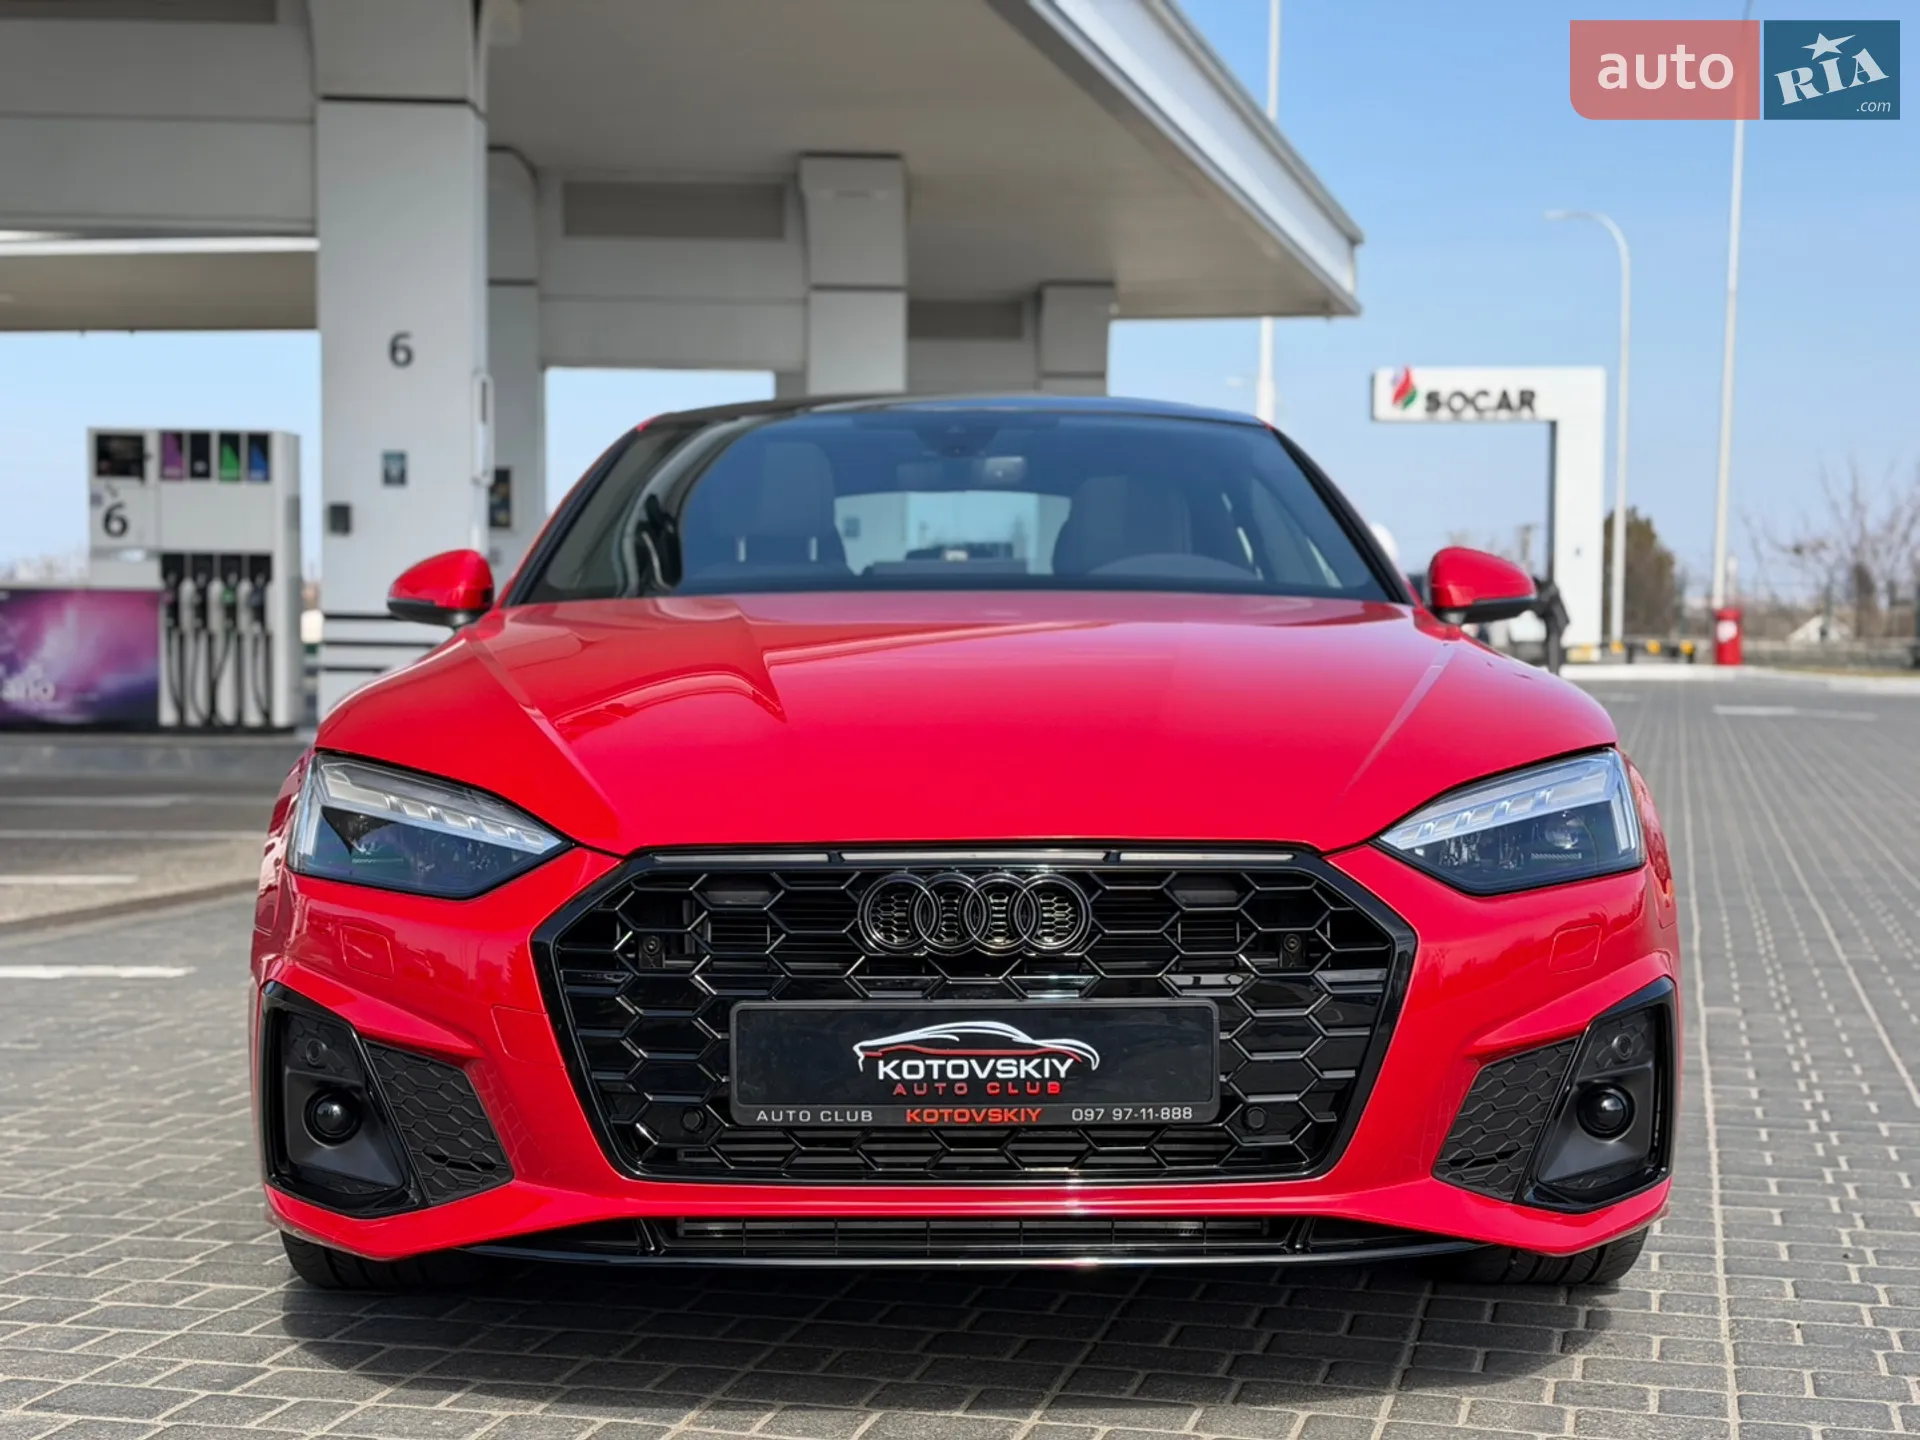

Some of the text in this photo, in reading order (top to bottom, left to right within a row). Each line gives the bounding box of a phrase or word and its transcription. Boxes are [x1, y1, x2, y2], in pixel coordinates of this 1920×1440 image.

[388, 332, 414, 368] 6
[1425, 389, 1536, 413] SOCAR
[103, 502, 128, 538] 6
[878, 1058, 1074, 1080] KOTOVSKIY
[892, 1081, 1061, 1096] AUTO CLUB
[757, 1107, 1193, 1123] AUTO CLUB KOTOVSKIY 097 97-11-888
